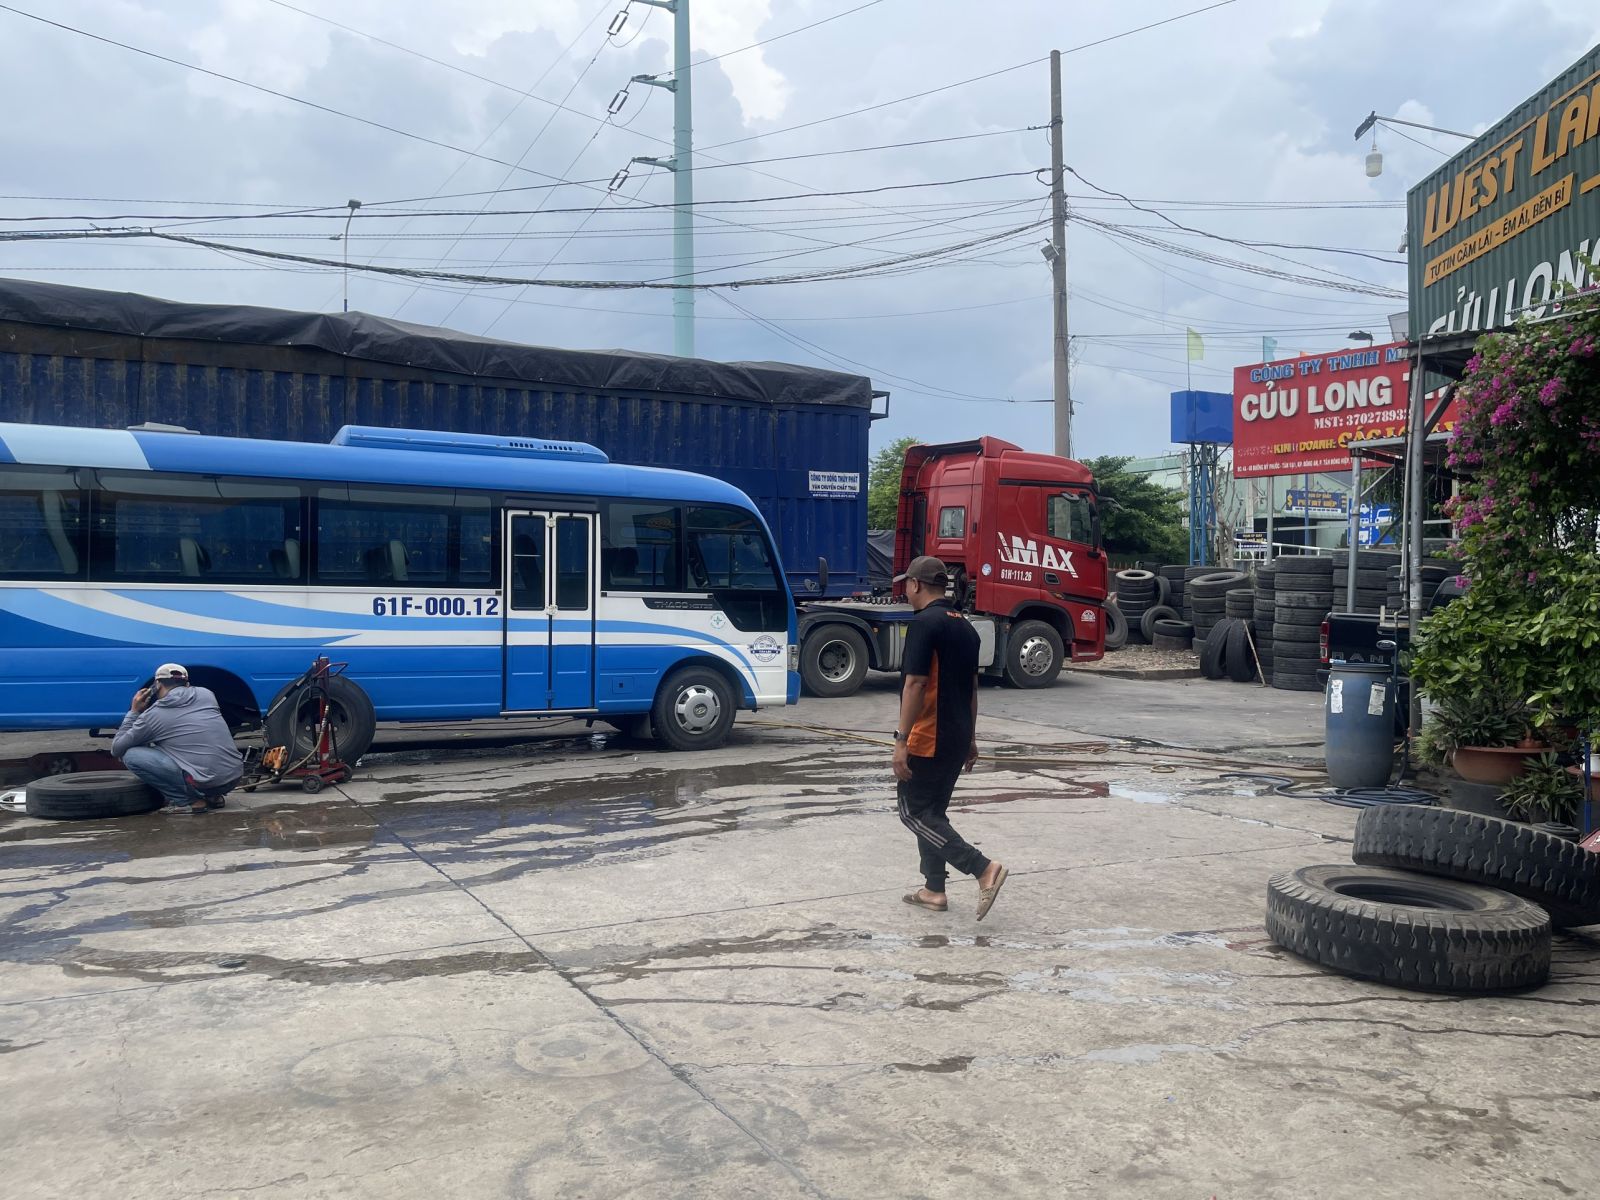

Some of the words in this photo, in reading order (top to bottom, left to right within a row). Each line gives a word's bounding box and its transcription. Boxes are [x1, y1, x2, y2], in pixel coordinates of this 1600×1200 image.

[1423, 138, 1523, 248] WEST
[1442, 253, 1456, 272] TIN
[1457, 240, 1477, 263] CẦM
[1478, 229, 1492, 251] LÁI
[1502, 218, 1516, 237] ÊM
[1533, 193, 1552, 219] BỀN
[1298, 358, 1323, 376] TY
[1328, 350, 1380, 371] TNHH
[1307, 375, 1393, 415] LONG
[1314, 415, 1344, 429] MST:
[1346, 408, 1411, 426] 37027893
[372, 597, 499, 616] 61F-000.12
